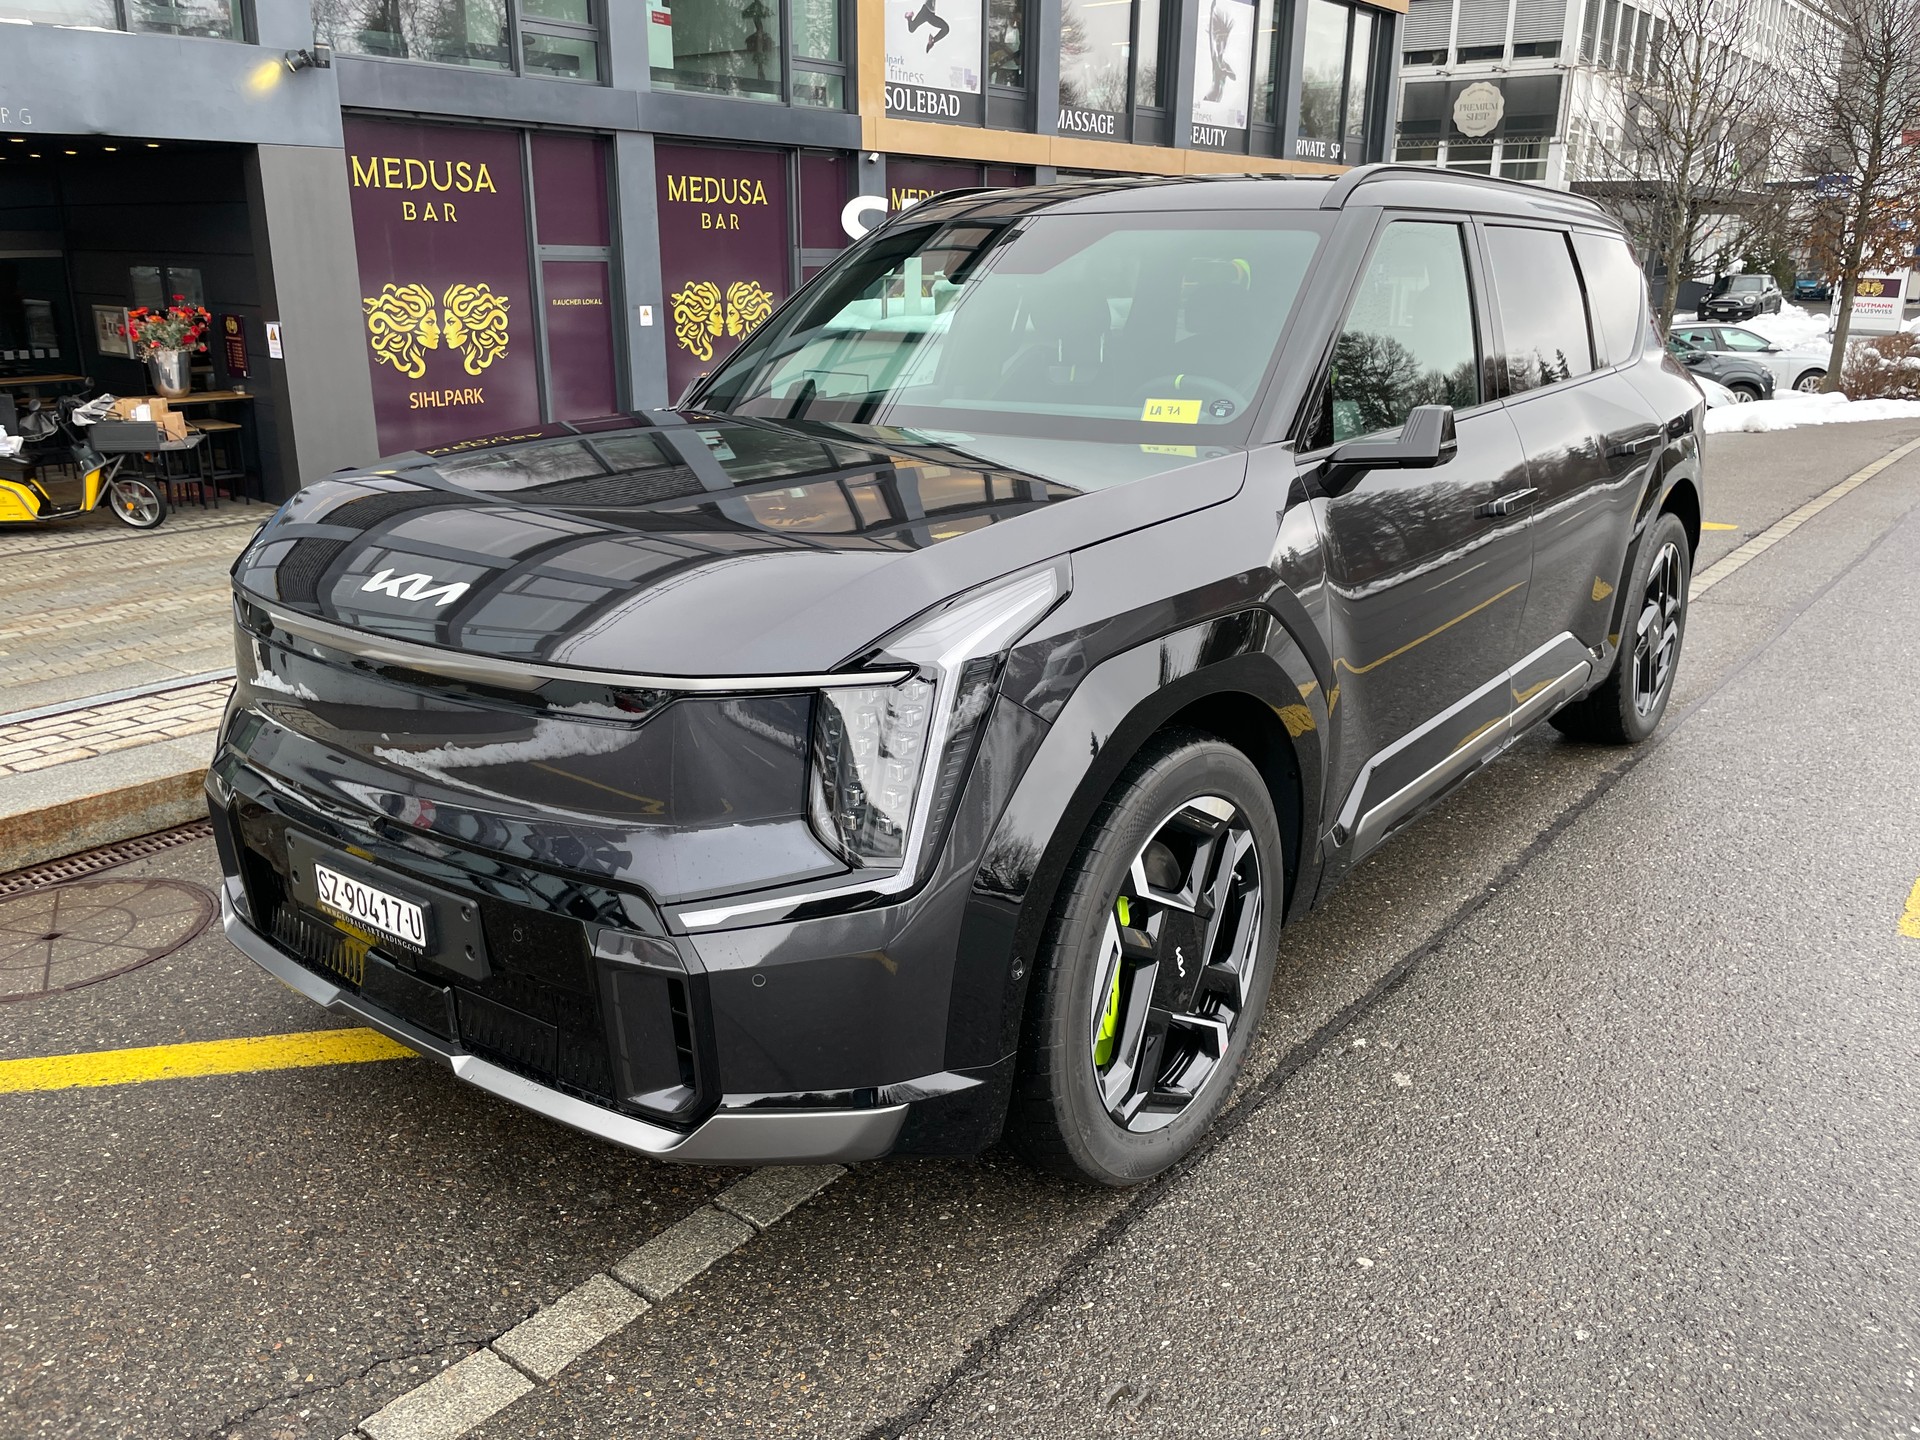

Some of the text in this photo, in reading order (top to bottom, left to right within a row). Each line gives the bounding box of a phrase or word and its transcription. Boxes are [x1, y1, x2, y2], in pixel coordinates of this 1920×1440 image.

[890, 65, 925, 84] fitness
[885, 86, 960, 117] SOLEBAD
[1459, 101, 1499, 112] PREMIUM
[1191, 125, 1228, 147] EAUTY
[350, 155, 497, 194] MEDUSA
[667, 174, 769, 206] MEDUSA
[402, 201, 458, 223] BAR
[701, 212, 740, 231] BAR
[582, 298, 603, 306] LOKAL
[409, 387, 485, 409] SIHLPARK
